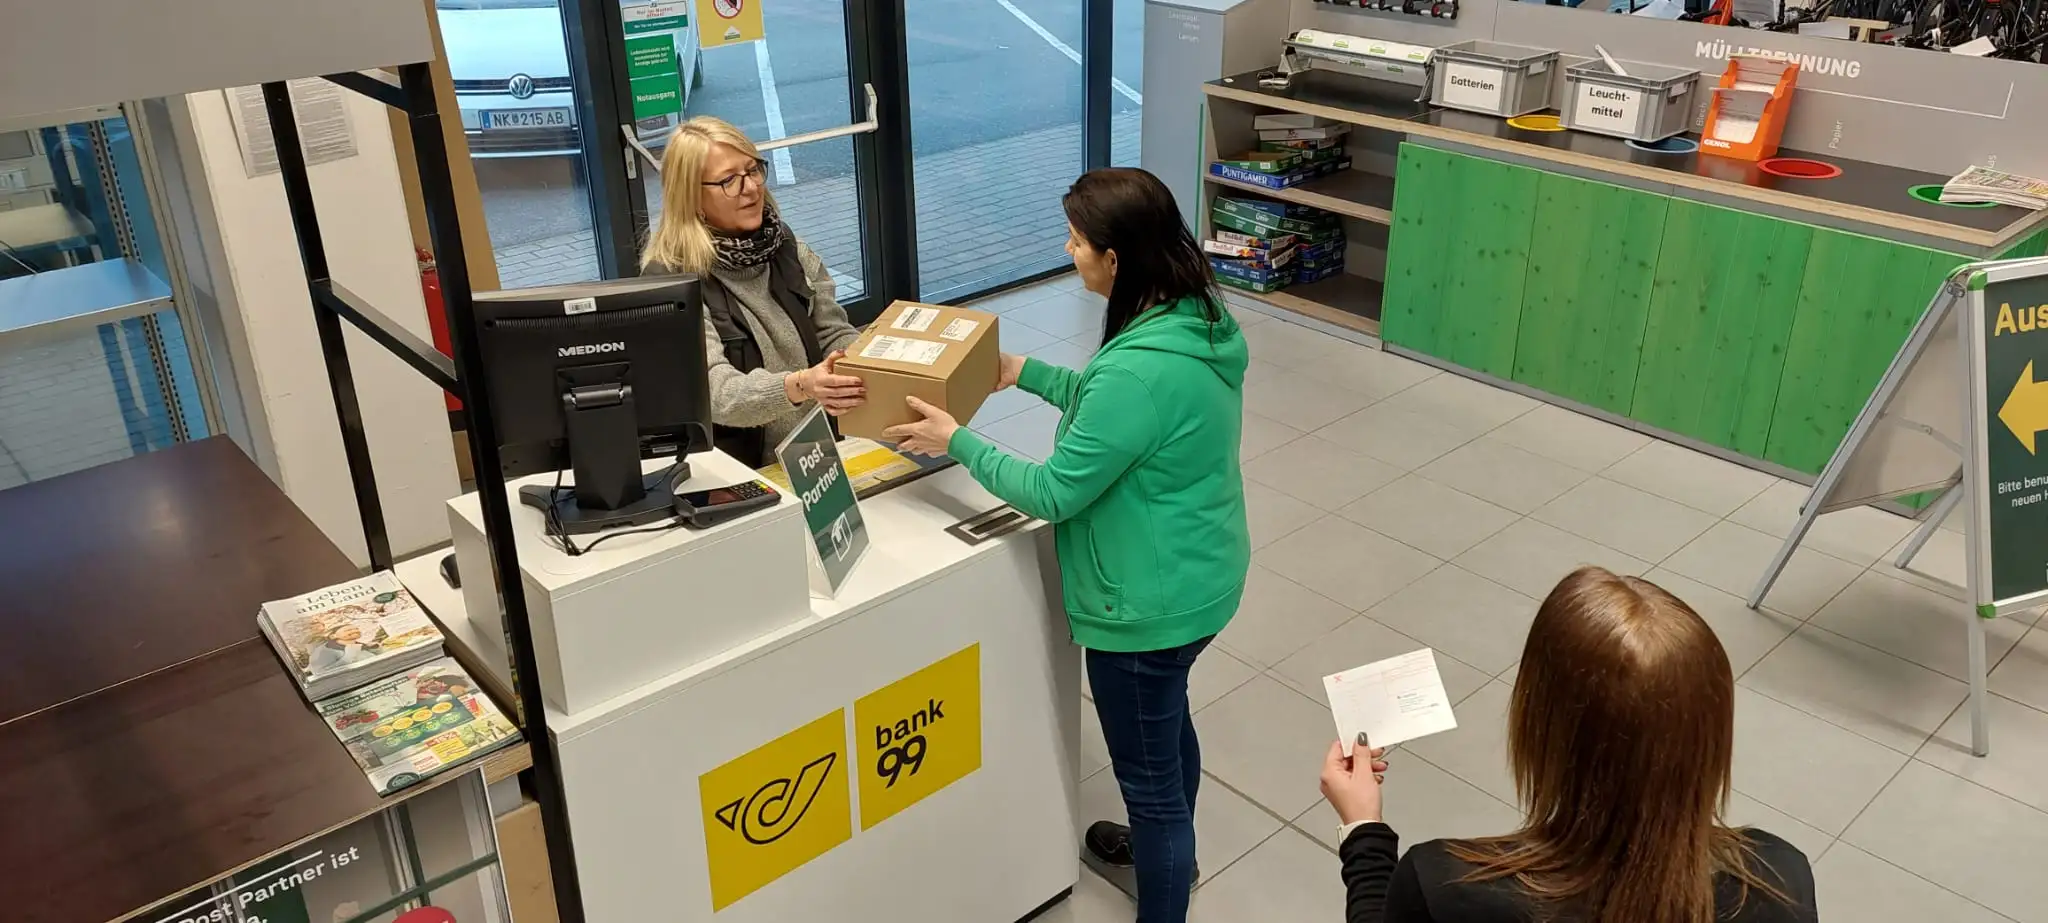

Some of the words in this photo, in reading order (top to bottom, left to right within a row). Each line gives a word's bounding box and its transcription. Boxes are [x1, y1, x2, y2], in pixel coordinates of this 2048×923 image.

[637, 91, 676, 103] Notausgang
[1589, 86, 1631, 102] Leucht-
[493, 112, 511, 127] NK
[520, 112, 543, 126] 215
[547, 111, 564, 125] AB
[1591, 105, 1624, 119] mittel
[1828, 120, 1844, 149] Papier
[1222, 165, 1268, 185] PUNTIGAMER
[558, 341, 625, 358] MEDION
[799, 441, 825, 478] Post
[802, 461, 840, 512] Partner
[1998, 481, 2022, 494] Bitte
[2012, 493, 2042, 507] neuen
[296, 602, 326, 614] am
[331, 586, 377, 605] Land
[306, 584, 363, 604] Leben
[876, 698, 945, 750] bank
[876, 734, 927, 789] 99
[238, 861, 325, 910] Partner
[331, 846, 361, 870] ist
